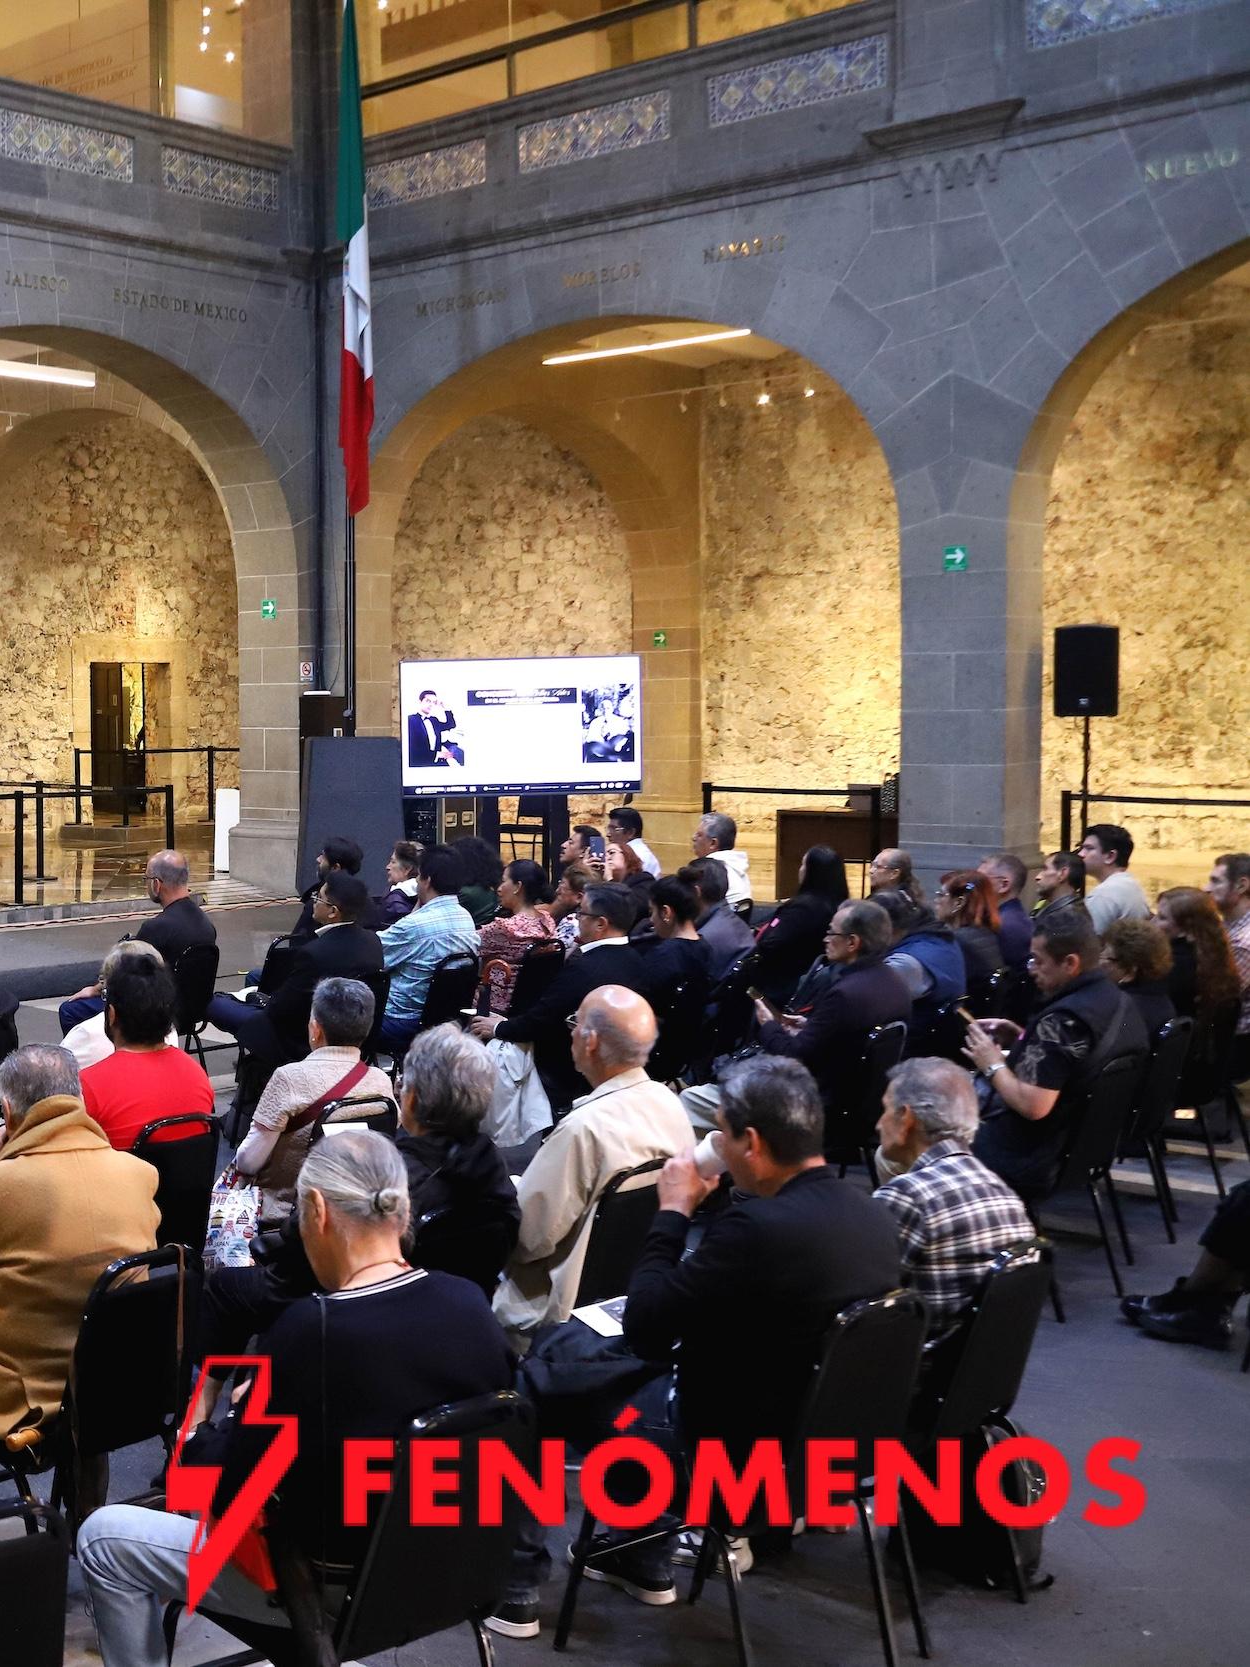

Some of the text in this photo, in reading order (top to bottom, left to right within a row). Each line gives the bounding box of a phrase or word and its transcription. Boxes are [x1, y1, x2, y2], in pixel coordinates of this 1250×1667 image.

[1144, 149, 1240, 184] NUEVO
[702, 234, 786, 264] NAYARIT
[5, 270, 70, 293] JALISCO
[562, 261, 641, 289] MORELOS
[112, 287, 170, 311] ESTADO
[173, 298, 191, 313] DE
